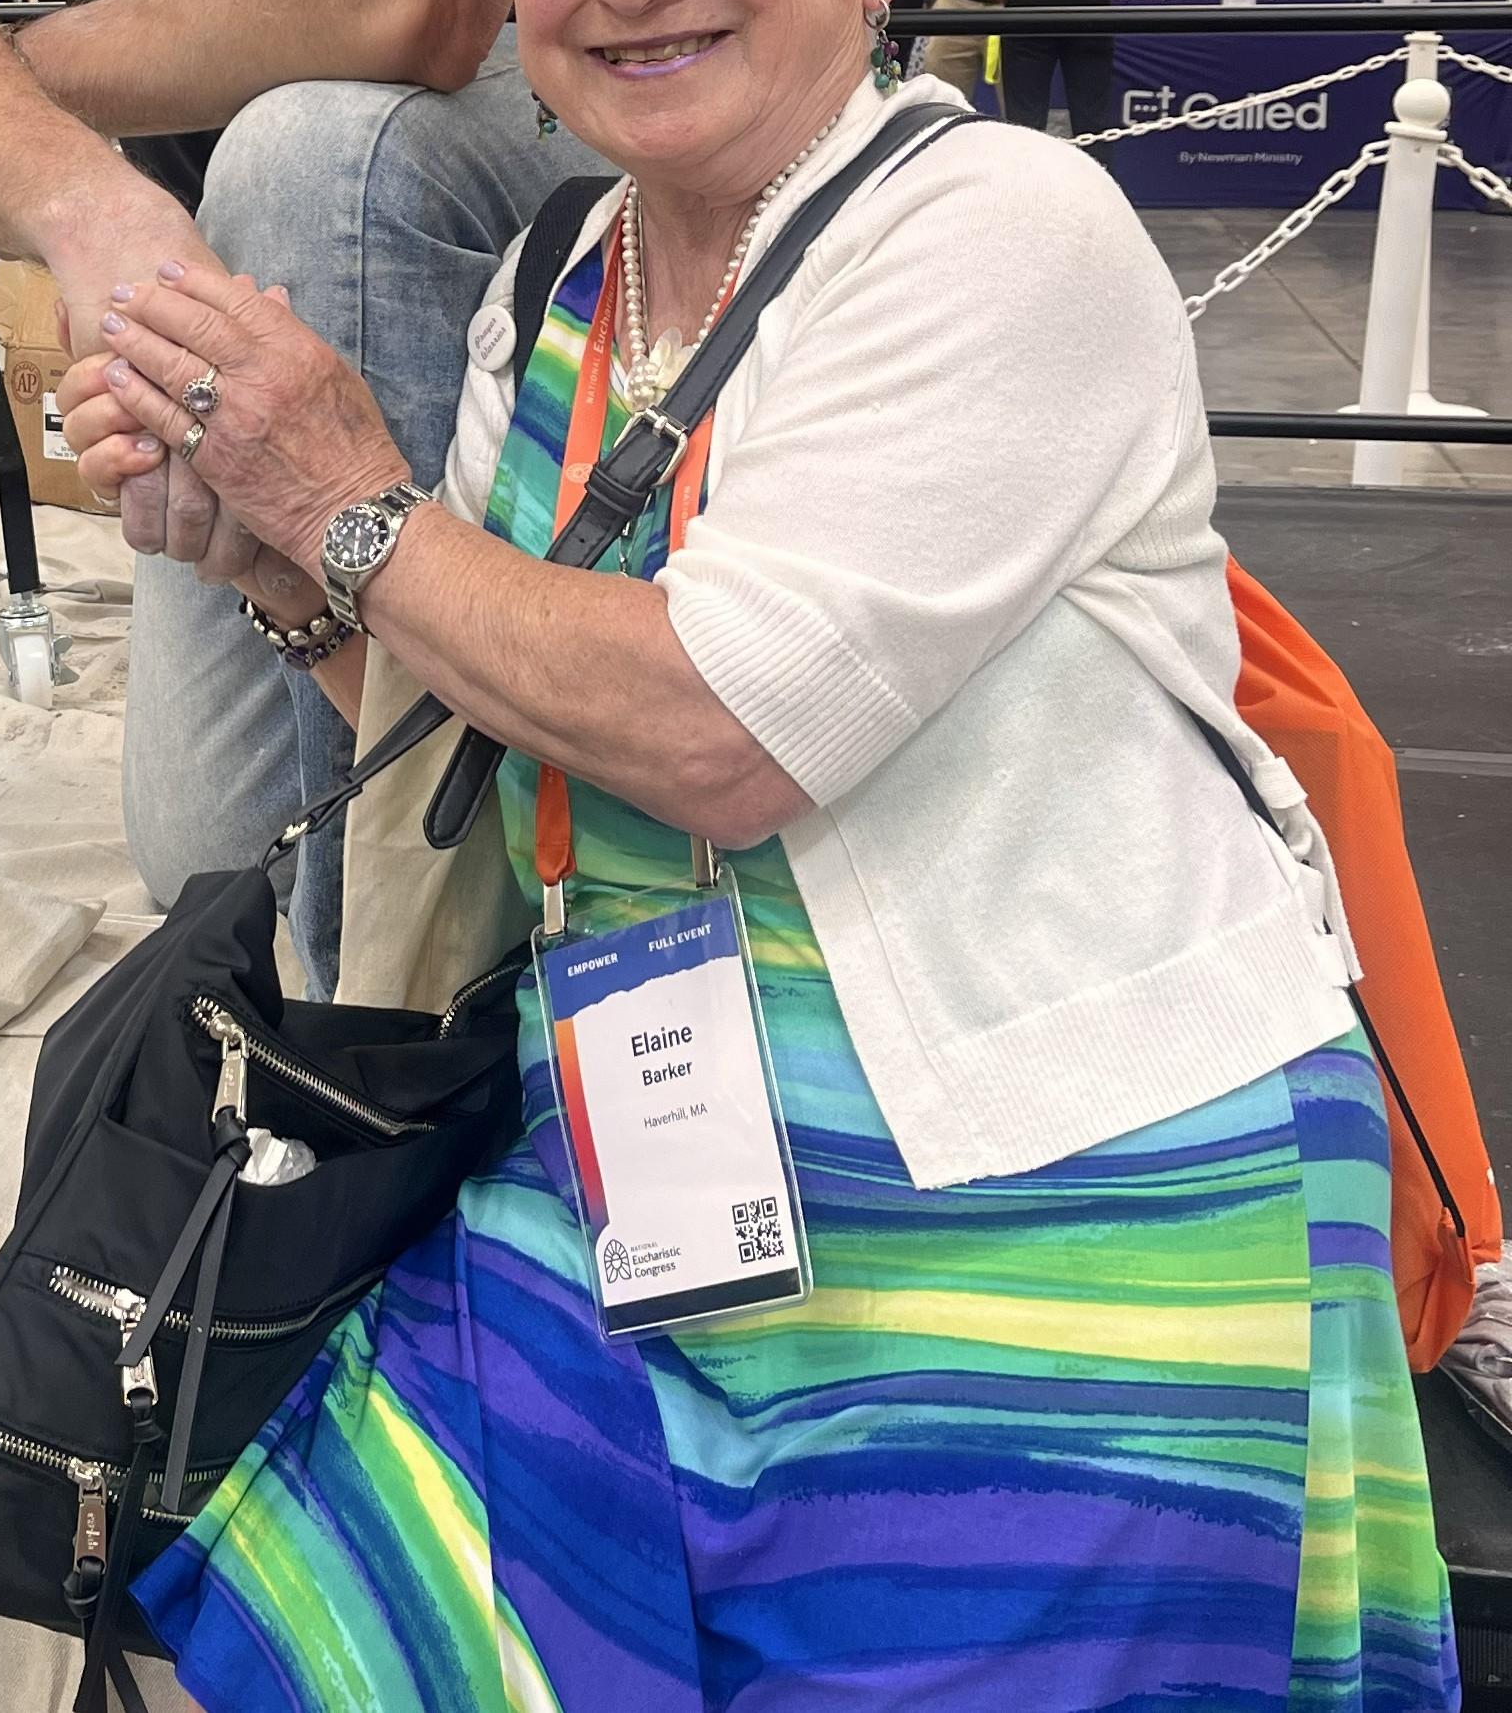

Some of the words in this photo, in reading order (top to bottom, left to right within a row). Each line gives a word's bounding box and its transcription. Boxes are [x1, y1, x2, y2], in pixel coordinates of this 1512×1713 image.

[1179, 151, 1197, 165] By
[1198, 151, 1252, 163] Newman
[1255, 151, 1303, 166] Ministry
[15, 372, 37, 393] AP
[586, 358, 601, 404] NATIONAL
[648, 935, 675, 952] FULL
[677, 923, 712, 944] EVENT
[567, 952, 619, 977] EMPOWER
[631, 1026, 693, 1057] Elaine
[642, 1061, 693, 1086] Barker
[644, 1107, 689, 1129] Haverhill,
[690, 1102, 708, 1117] MA
[630, 1241, 659, 1252] NATIONAL
[632, 1246, 681, 1265] Eucharistic
[634, 1262, 676, 1278] Congress
